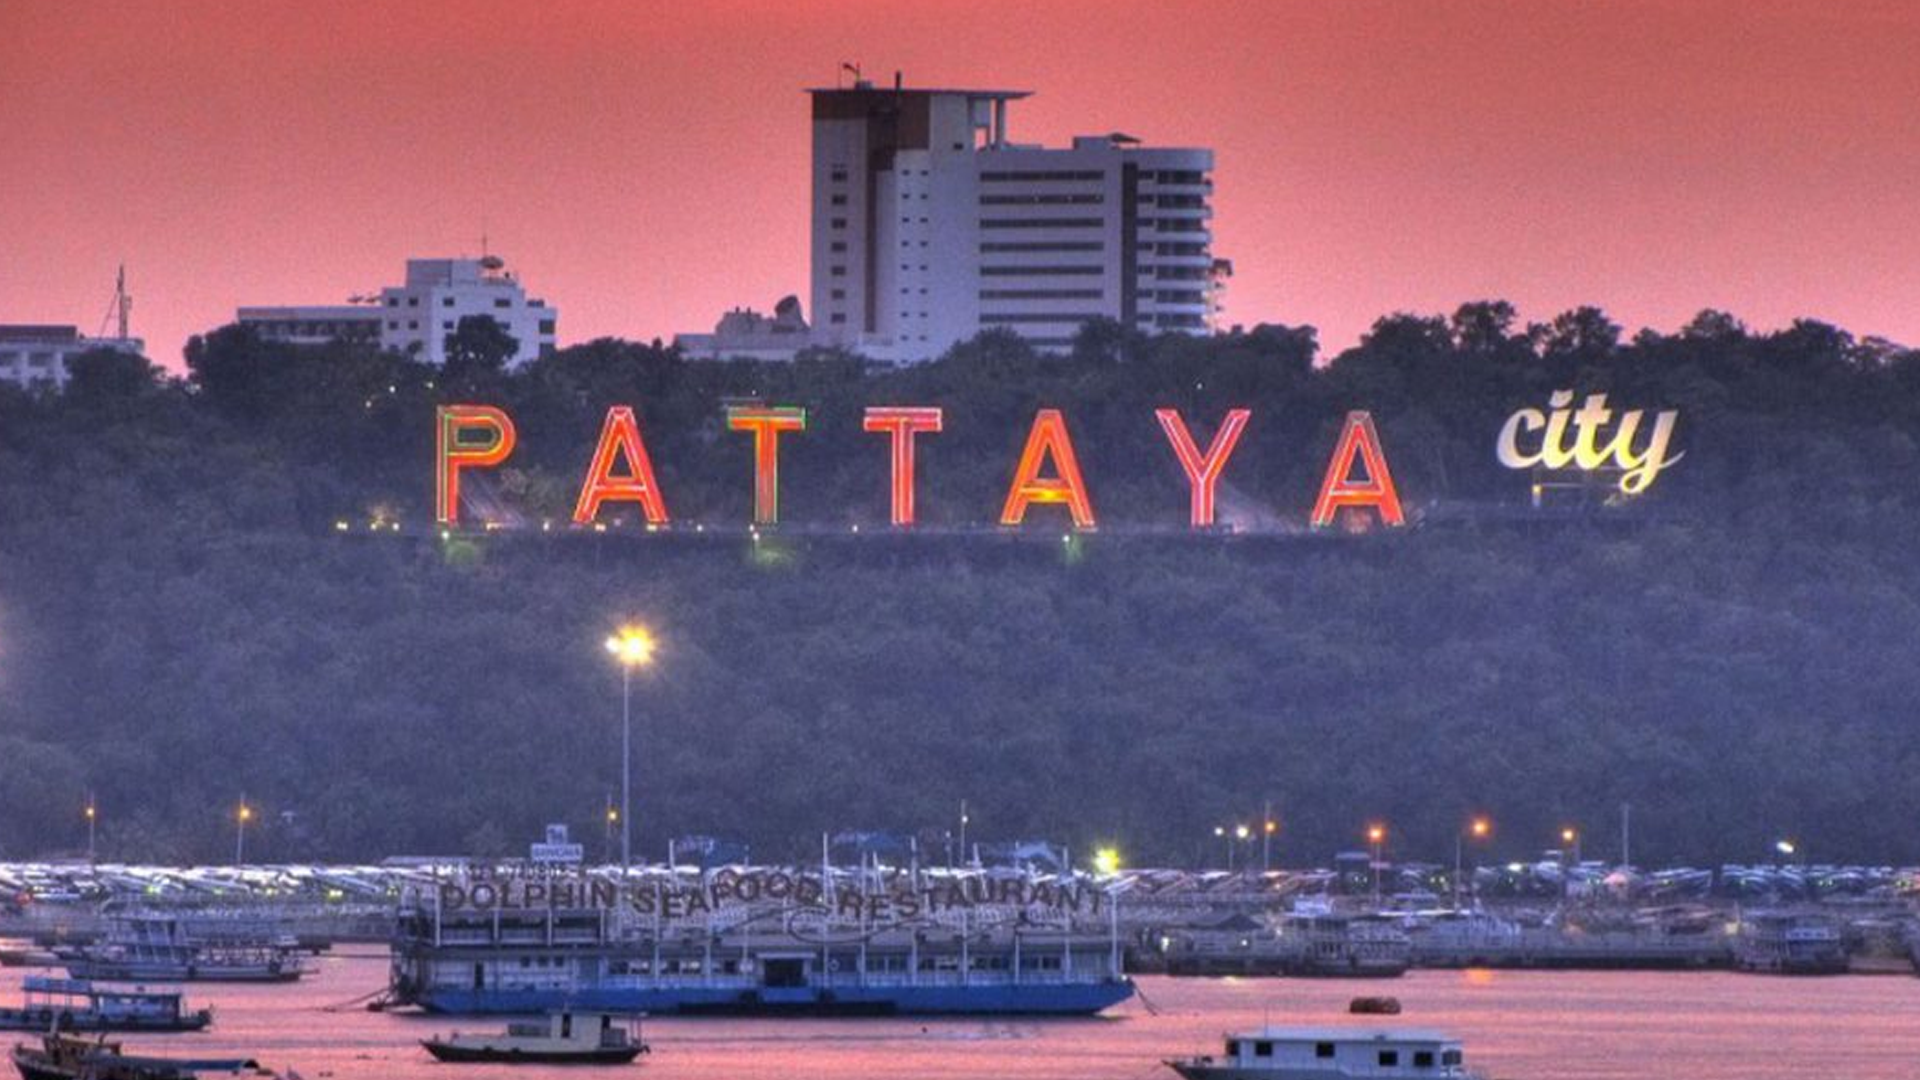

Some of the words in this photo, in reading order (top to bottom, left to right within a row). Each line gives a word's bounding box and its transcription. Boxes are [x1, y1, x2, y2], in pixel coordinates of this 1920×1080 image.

[437, 404, 1405, 526] PATTAYA
[1497, 389, 1686, 494] city
[440, 880, 616, 909] DOLPHIN
[632, 869, 824, 918] SEAFOOD
[838, 877, 1109, 920] RESTAURANT
